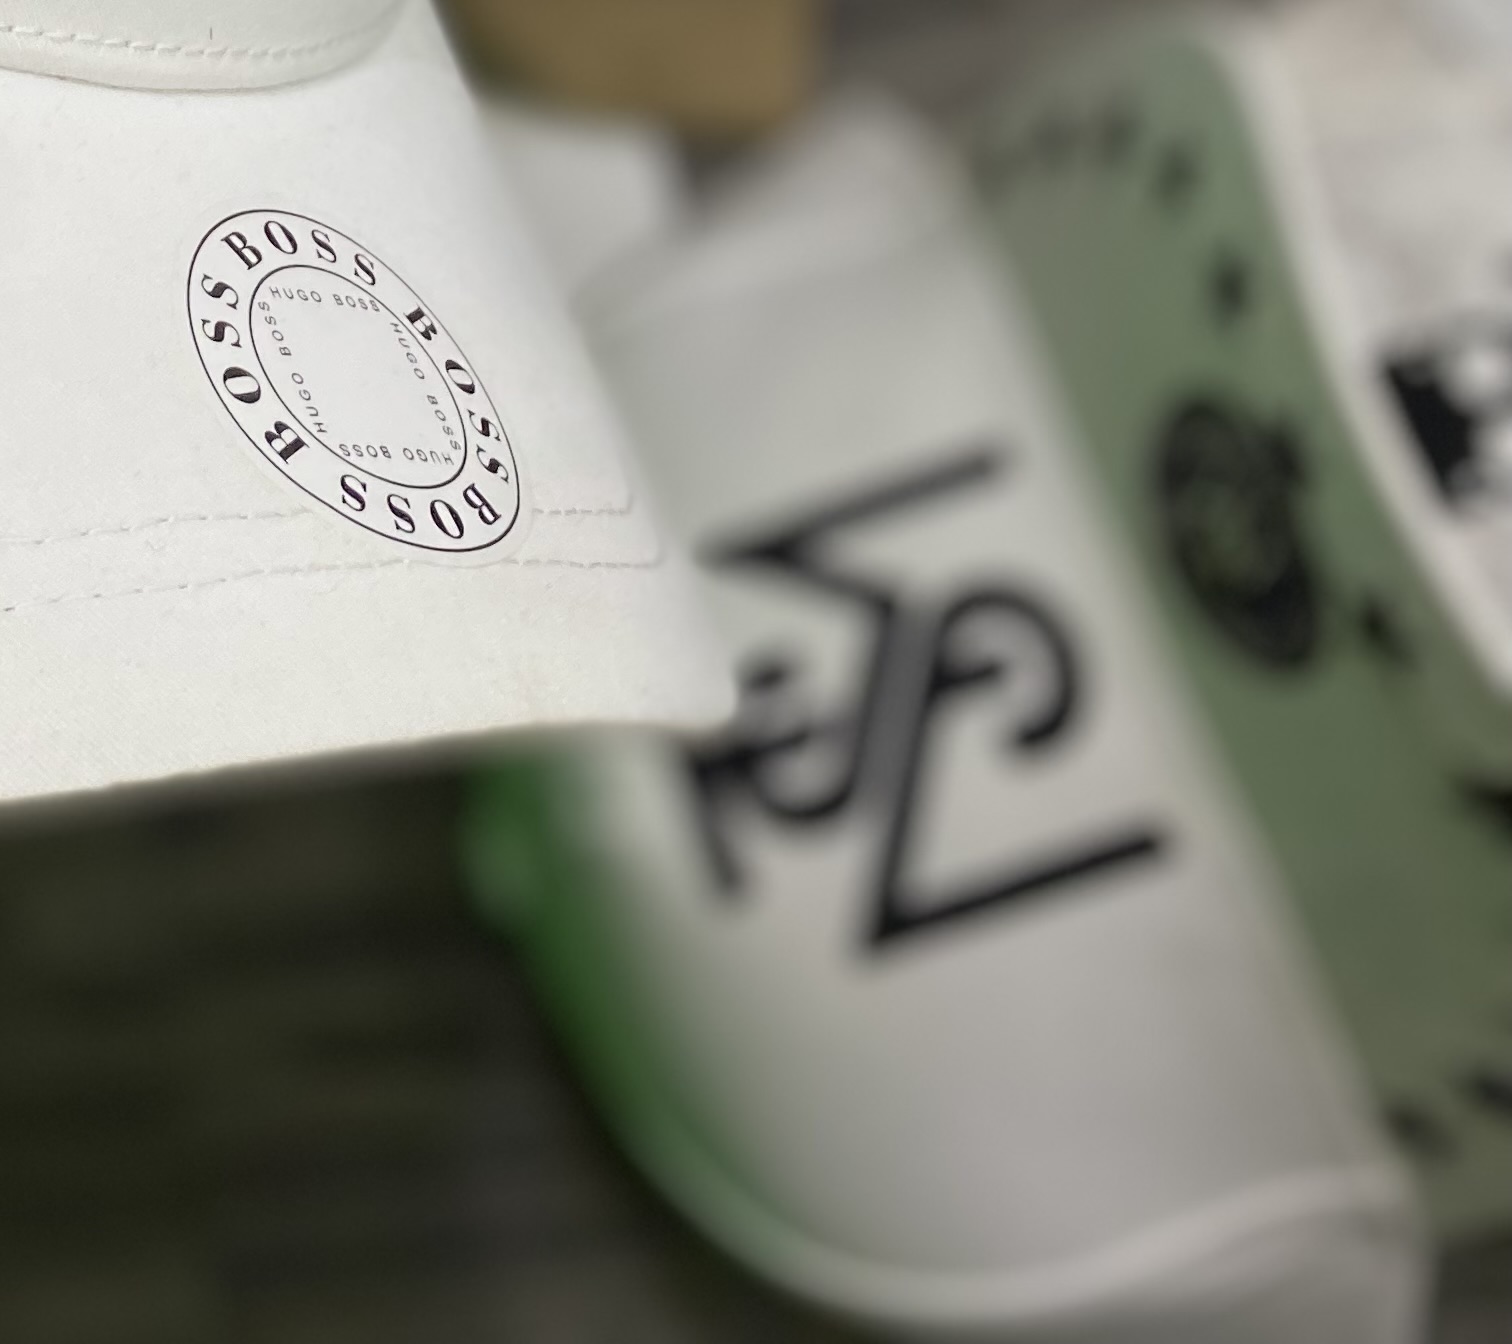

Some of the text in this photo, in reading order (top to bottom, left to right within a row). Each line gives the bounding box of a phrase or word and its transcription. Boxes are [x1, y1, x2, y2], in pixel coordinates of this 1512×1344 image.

[221, 221, 376, 286] BOSS
[270, 286, 379, 312] HUGO BOSS
[201, 274, 309, 464] BOSS
[258, 301, 328, 433] HUGO BOSS
[391, 323, 461, 450] HUGO BOSS
[404, 307, 509, 483] BOSS
[339, 444, 453, 465] HUGO BOSS
[340, 475, 502, 539] BOSS
